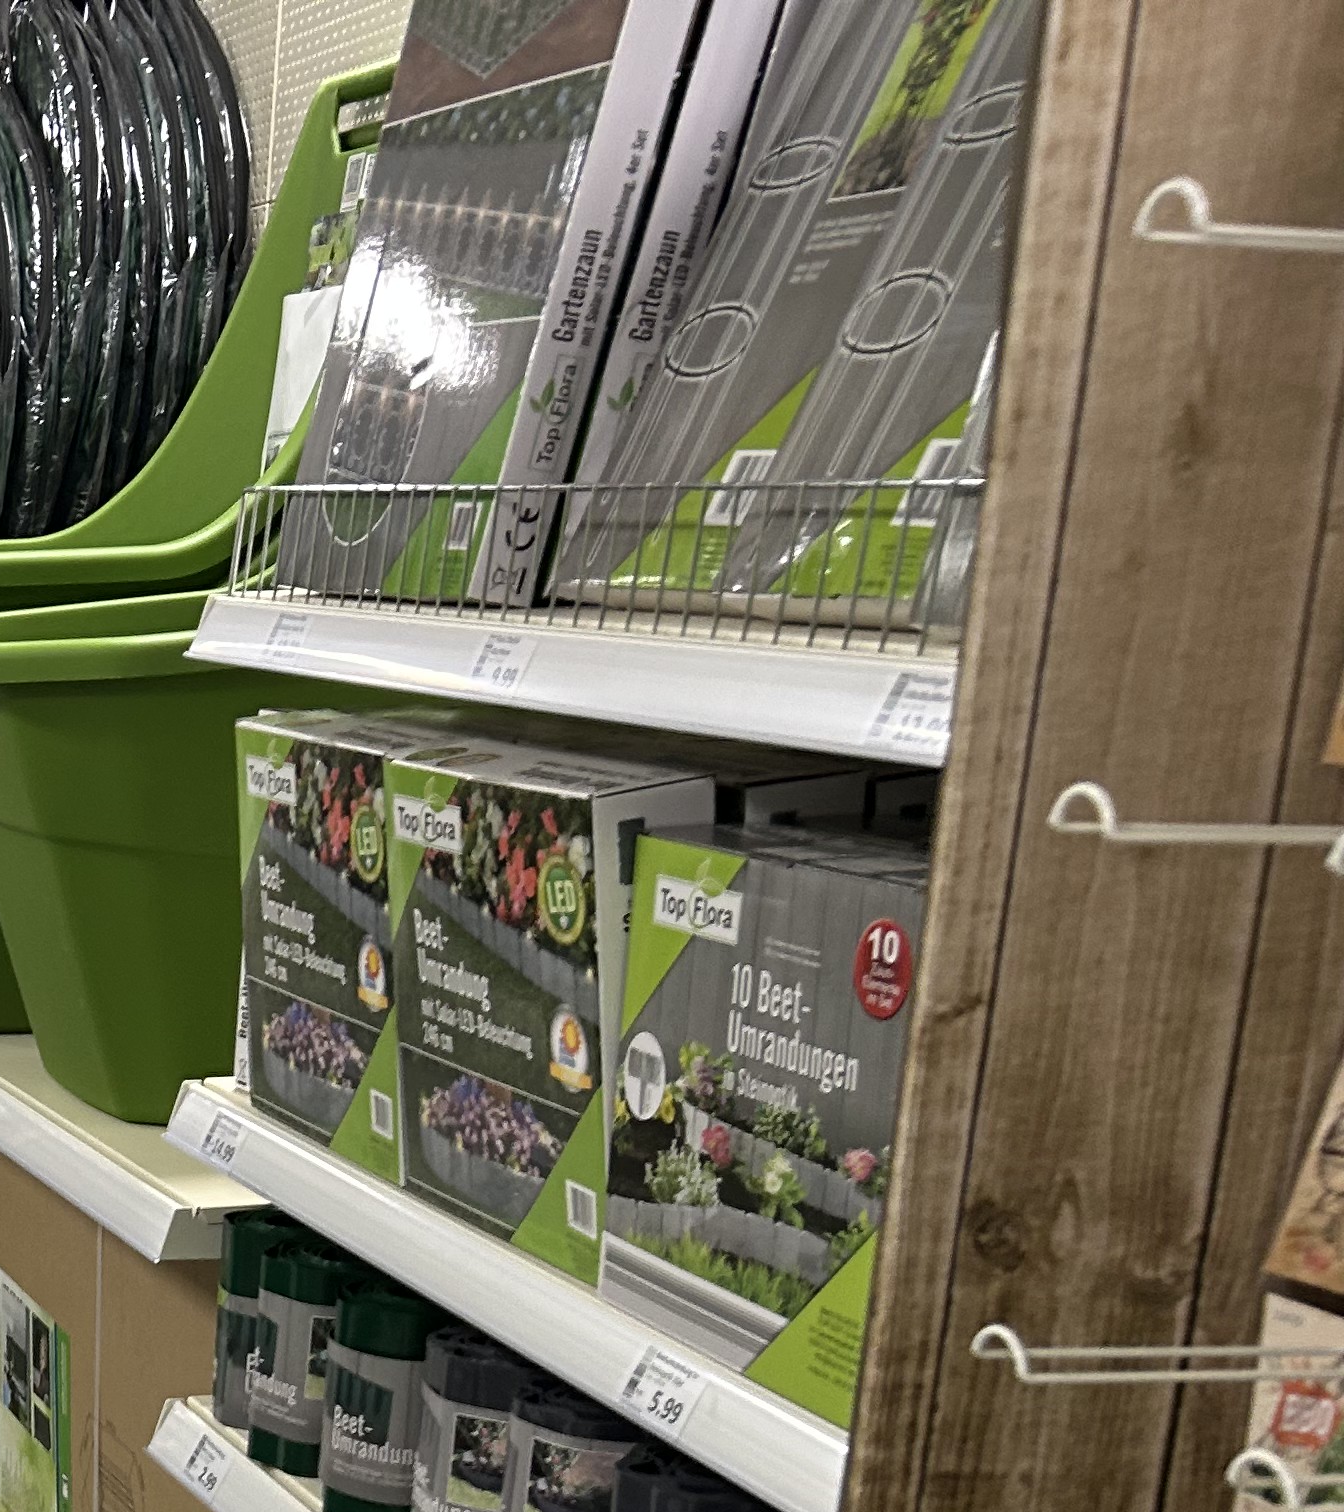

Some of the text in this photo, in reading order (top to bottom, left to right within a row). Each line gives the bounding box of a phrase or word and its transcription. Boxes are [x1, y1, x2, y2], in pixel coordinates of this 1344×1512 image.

[552, 229, 603, 342] Gartenzaun
[629, 229, 681, 343] Gartenzaun
[536, 364, 577, 463] Top Flora
[248, 764, 292, 796] Top Flora
[358, 828, 378, 855] LED
[397, 805, 456, 841] Top Flora
[259, 854, 286, 892] Beet-
[545, 879, 576, 914] LED
[661, 887, 733, 929] Top Flora
[260, 889, 316, 945] Umrandung
[413, 907, 449, 951] Beet-
[867, 926, 900, 965] 10
[416, 946, 492, 1012] Umrandung
[731, 962, 753, 1009] 10
[757, 969, 812, 1025] Beet-
[726, 1009, 860, 1094] Umrandungen
[212, 1138, 236, 1163] 14.99
[332, 1403, 373, 1437] Beet-
[648, 1390, 684, 1425] 5.99
[198, 1467, 218, 1492] 2.99
